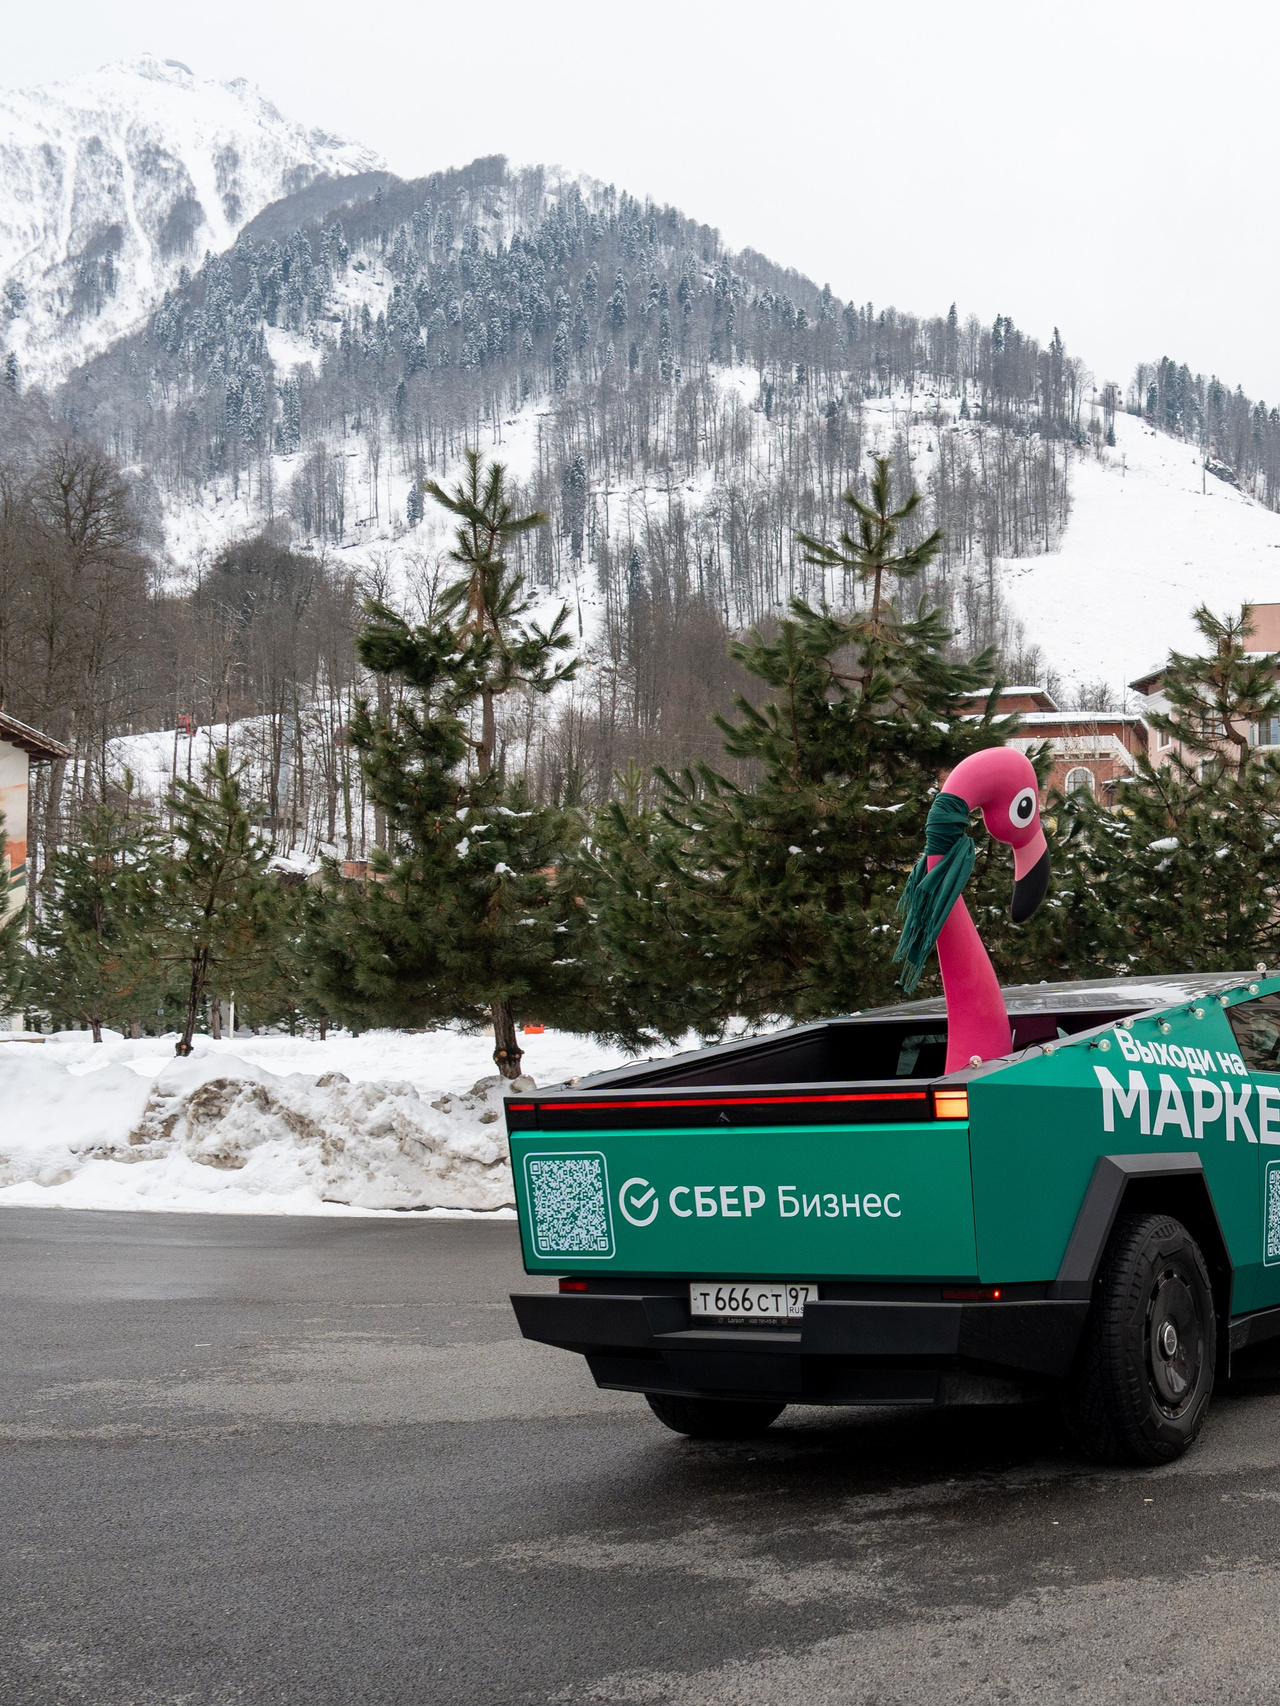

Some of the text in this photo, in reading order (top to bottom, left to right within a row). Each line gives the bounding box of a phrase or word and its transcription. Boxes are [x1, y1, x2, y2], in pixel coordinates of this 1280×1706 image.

[1114, 1028, 1249, 1076] Выходи на
[669, 1185, 902, 1218] СБЕР Бизнес
